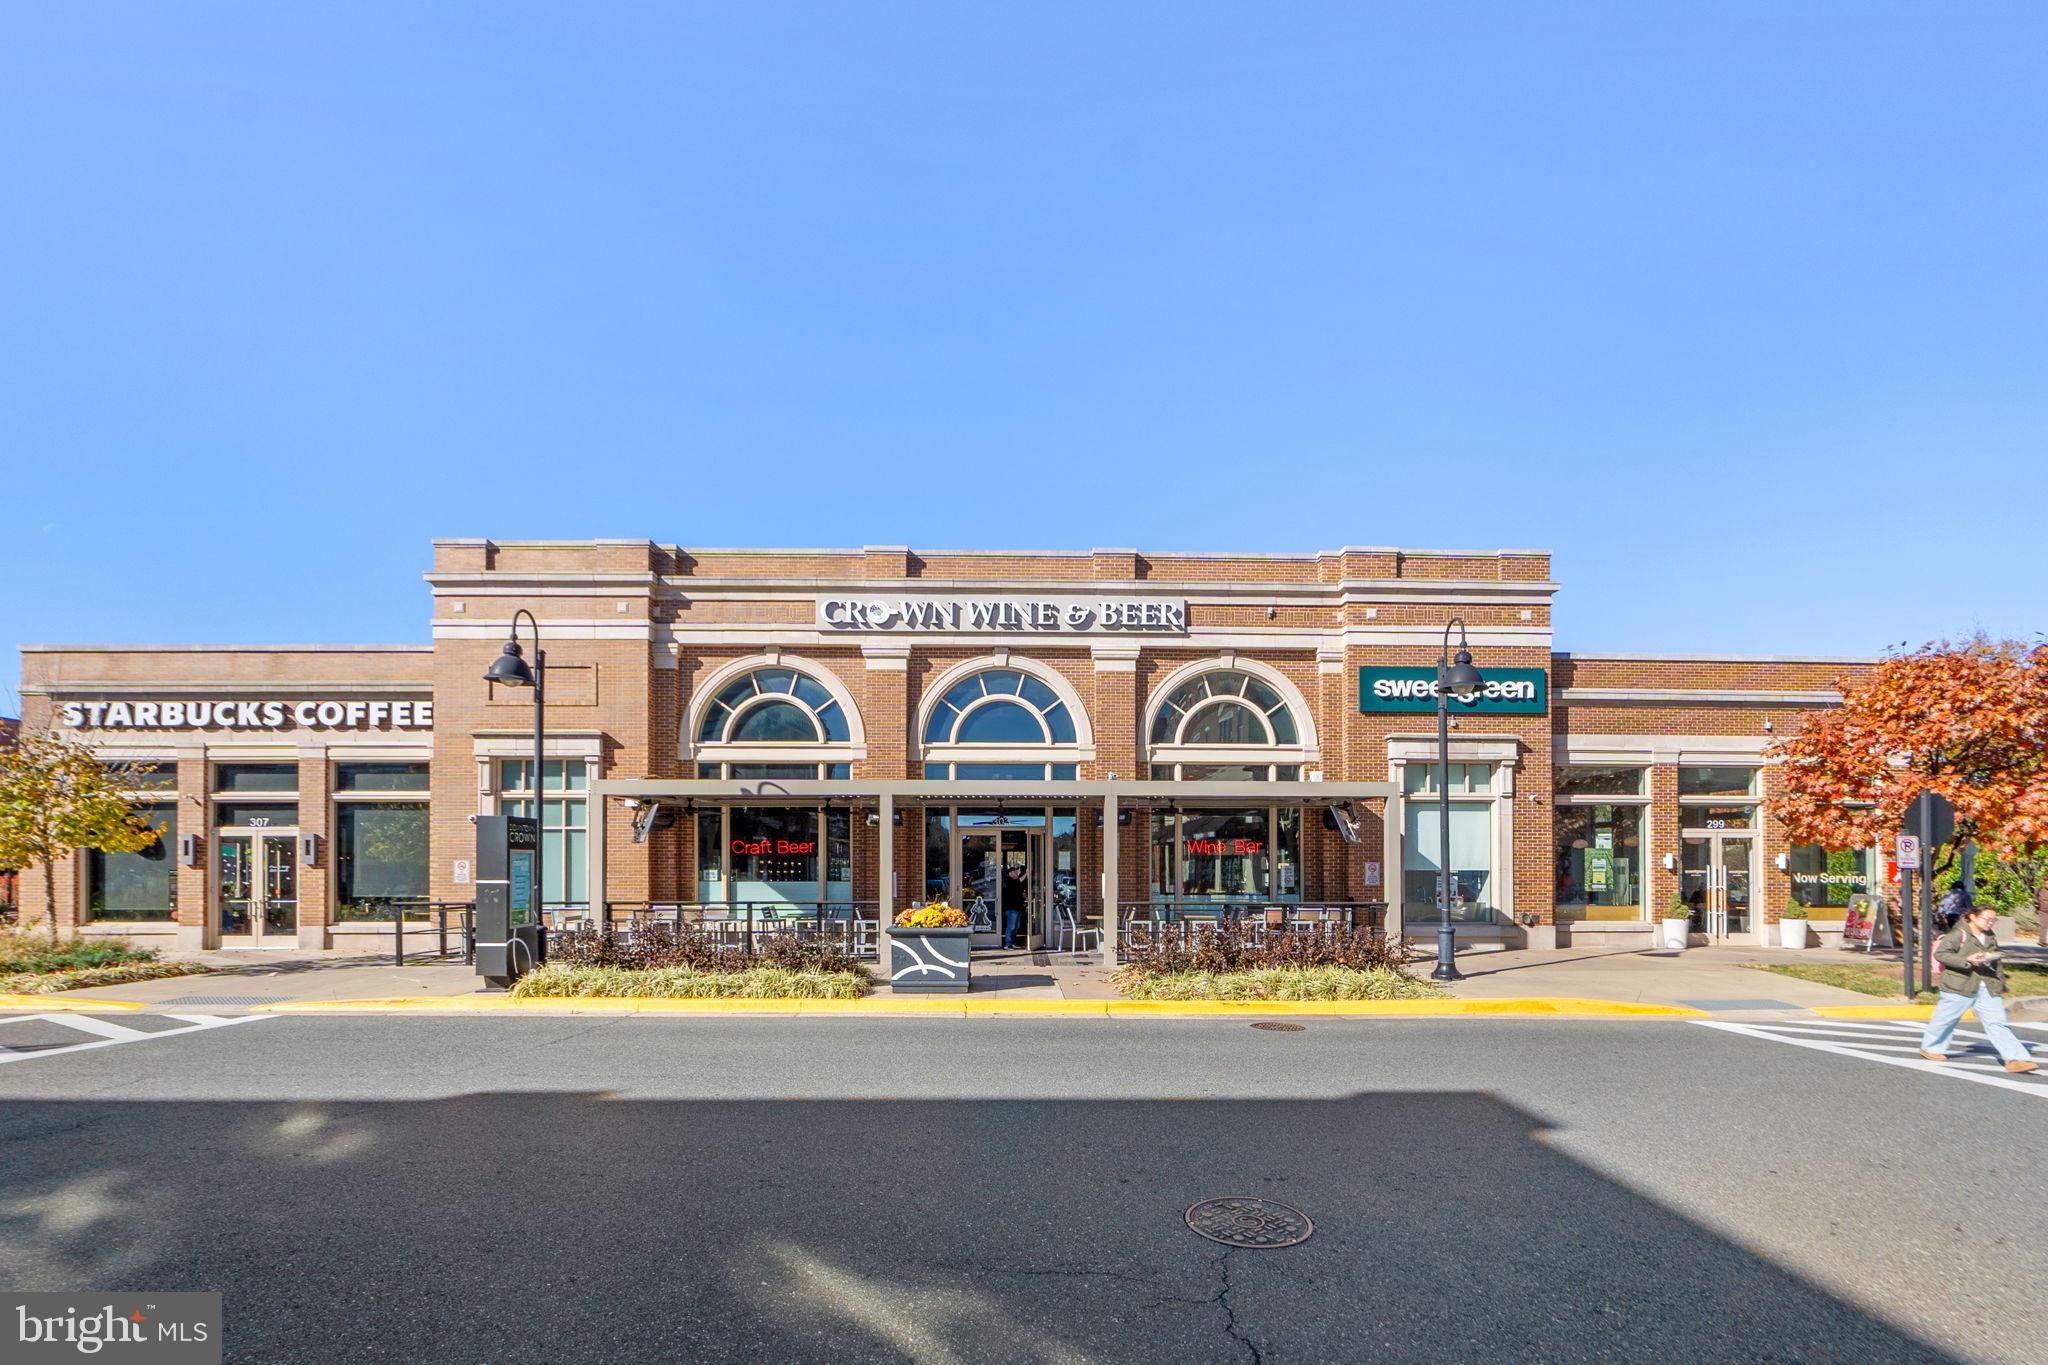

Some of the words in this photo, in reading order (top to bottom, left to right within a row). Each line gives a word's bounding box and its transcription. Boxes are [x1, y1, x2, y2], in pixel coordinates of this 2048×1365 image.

[820, 599, 955, 625] CROWN
[965, 600, 1055, 626] WINE
[1063, 602, 1091, 626] &
[1100, 601, 1181, 627] BEER
[1373, 679, 1535, 703] sweeeen
[62, 701, 285, 727] STARBUCKS
[294, 701, 433, 727] COFFEE
[249, 817, 270, 828] 307
[1706, 819, 1725, 829] 299
[509, 832, 536, 843] CROWN
[731, 839, 773, 855] Craft
[777, 840, 816, 855] Beer
[1187, 839, 1228, 855] Wine
[1234, 839, 1264, 854] Bar
[1792, 872, 1818, 884] Now
[1820, 872, 1867, 886] Serving
